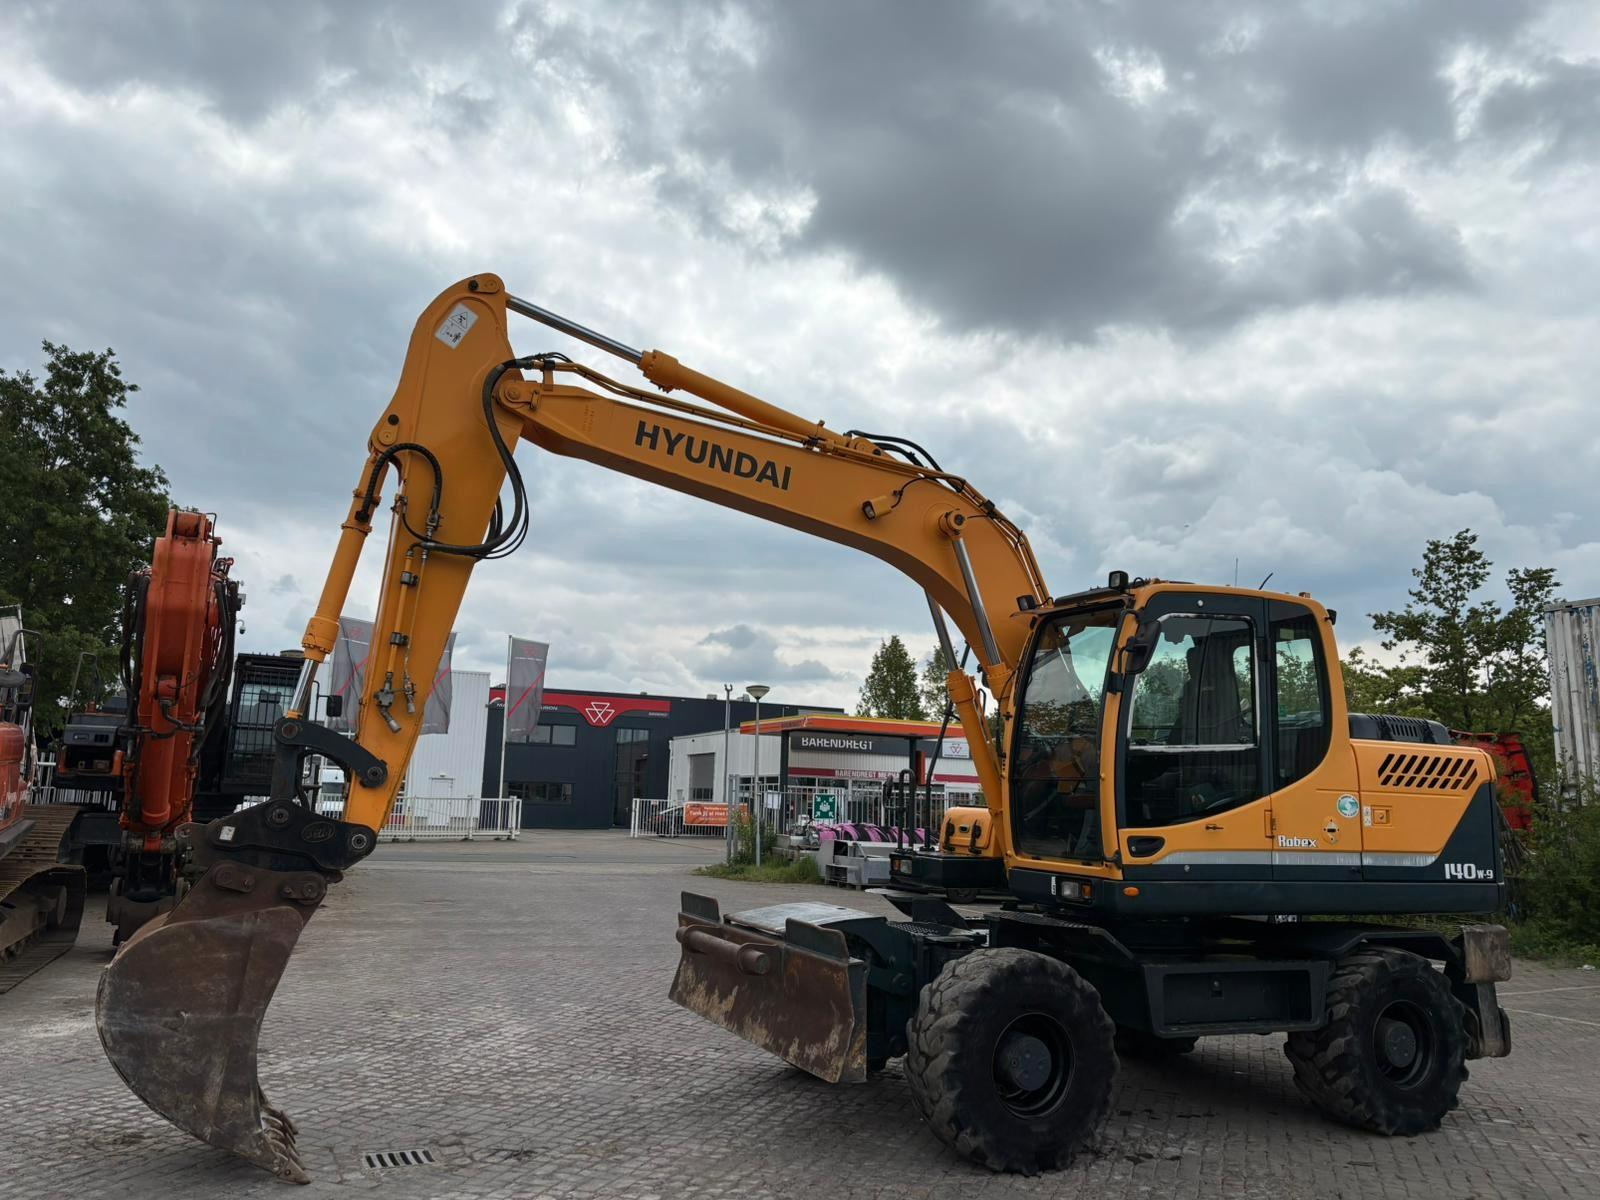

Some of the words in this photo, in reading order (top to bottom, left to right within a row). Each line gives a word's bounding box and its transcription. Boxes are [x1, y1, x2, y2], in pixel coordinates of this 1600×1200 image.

[635, 420, 792, 491] HYUNDAI
[801, 736, 873, 751] BARENDREGT
[1277, 834, 1317, 848] Robex
